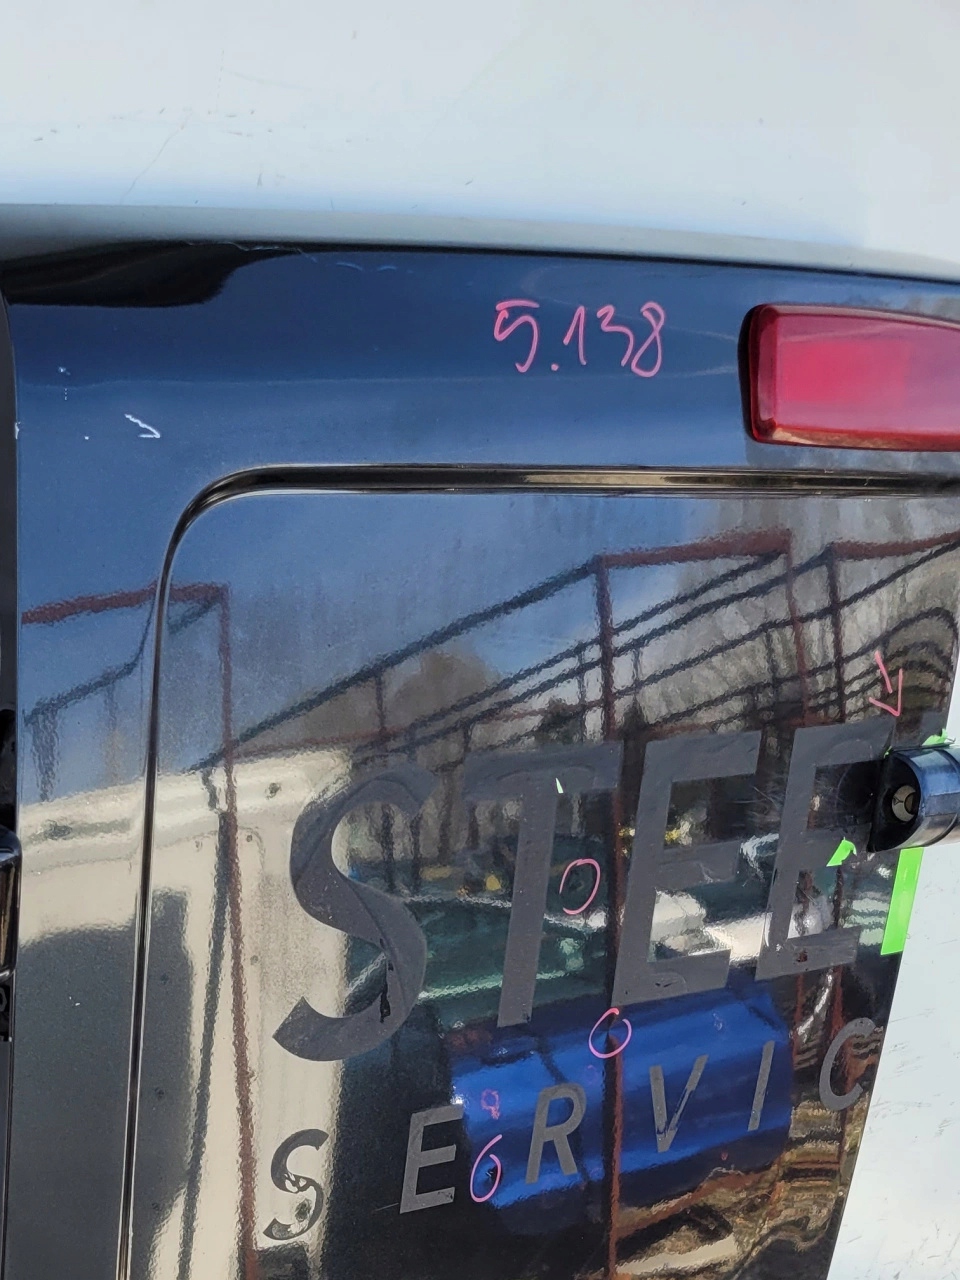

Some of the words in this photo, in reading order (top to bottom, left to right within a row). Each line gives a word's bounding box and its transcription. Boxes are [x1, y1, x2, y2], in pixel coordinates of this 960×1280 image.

[493, 299, 665, 377] 5.138
[272, 710, 949, 1062] STEE
[262, 1017, 877, 1242] SERVIC
